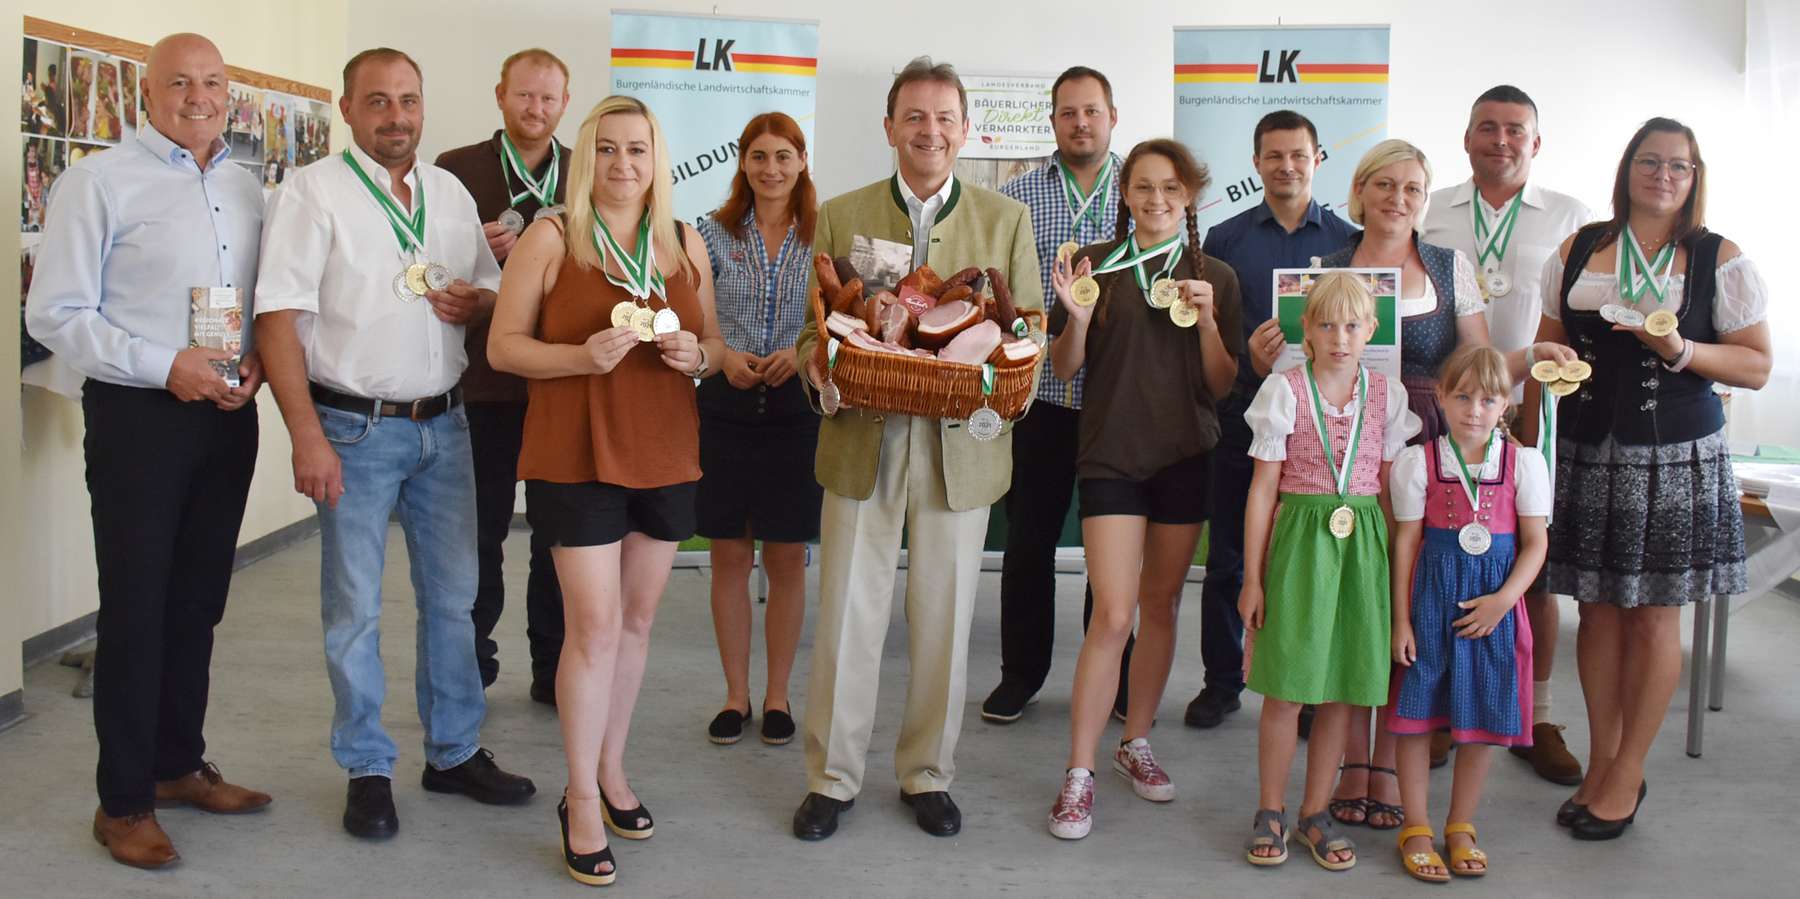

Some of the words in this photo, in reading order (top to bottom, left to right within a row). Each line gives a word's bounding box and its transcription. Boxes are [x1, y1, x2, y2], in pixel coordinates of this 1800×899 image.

[695, 38, 736, 72] LK
[1259, 49, 1301, 84] LK
[616, 79, 697, 93] Burgenländische
[698, 83, 810, 97] Landwirtschaftskammer
[1179, 95, 1260, 107] Burgenländische
[1262, 95, 1383, 106] Landwirtschaftskammer
[983, 107, 1045, 124] Direkt
[974, 124, 1051, 134] VERMARKTER
